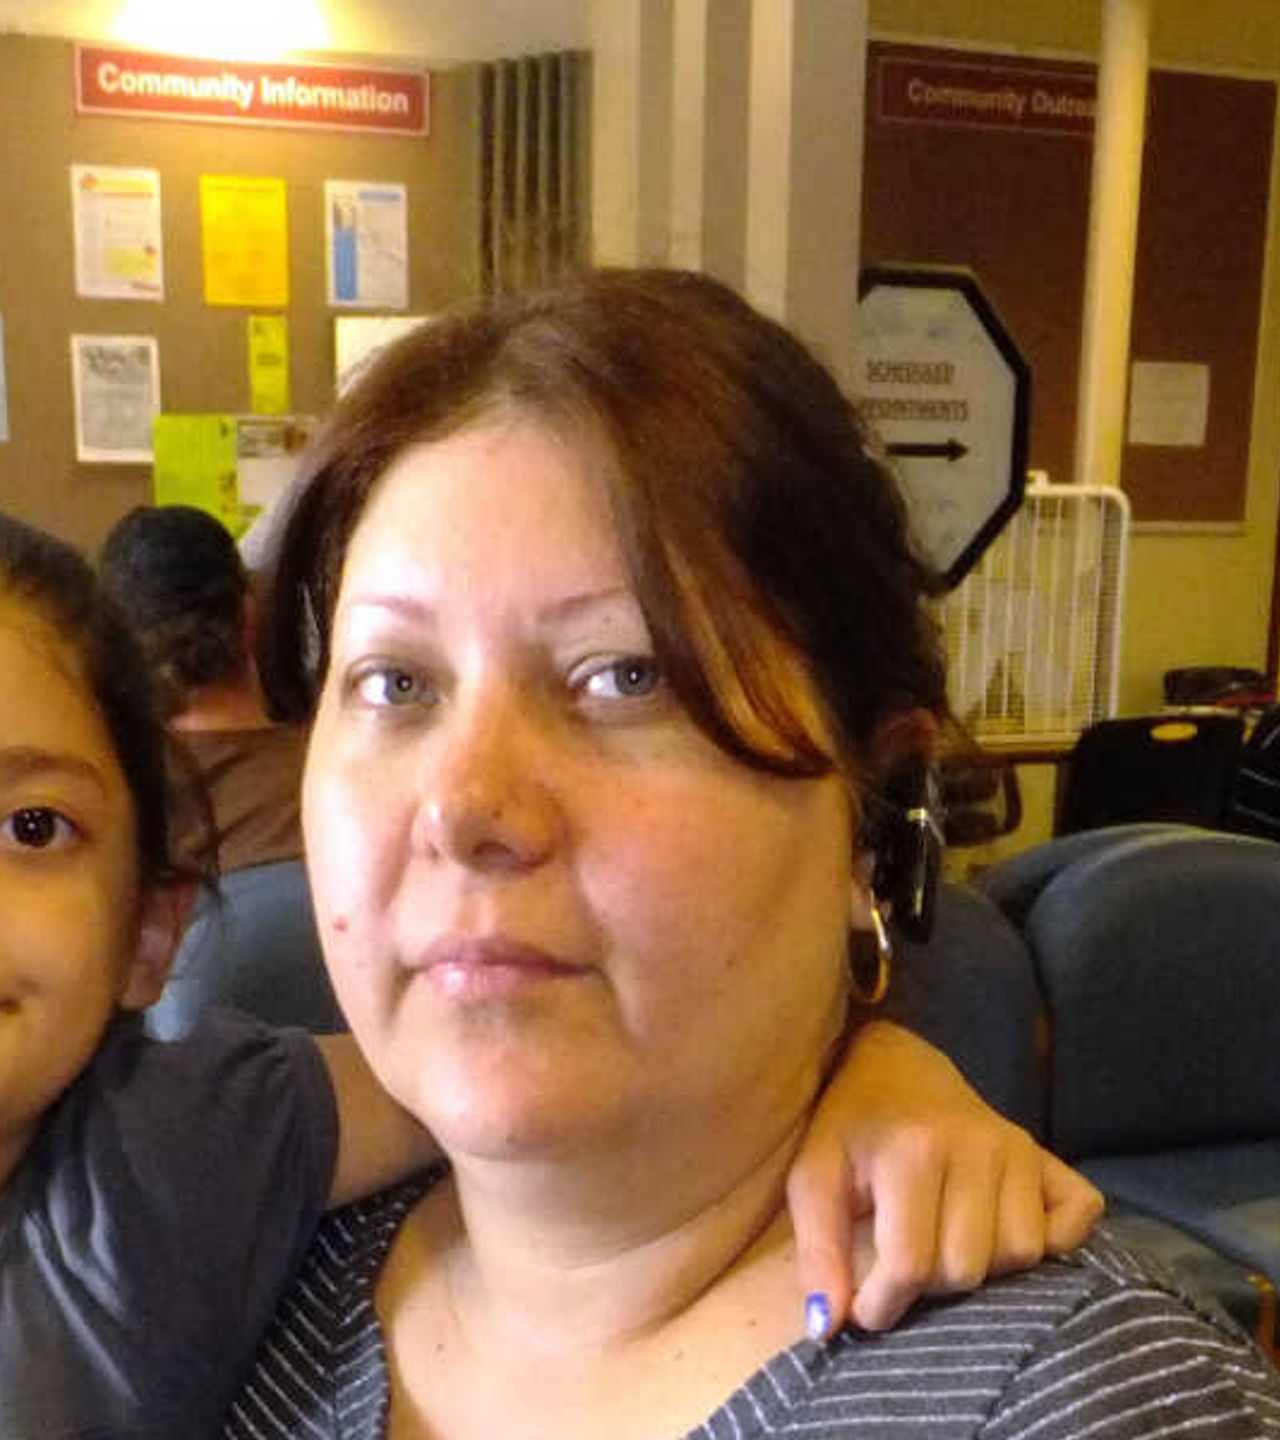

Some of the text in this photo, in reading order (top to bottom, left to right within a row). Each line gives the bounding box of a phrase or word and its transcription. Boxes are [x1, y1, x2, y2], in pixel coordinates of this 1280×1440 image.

[98, 63, 408, 114] Community Information
[908, 77, 1025, 118] Community
